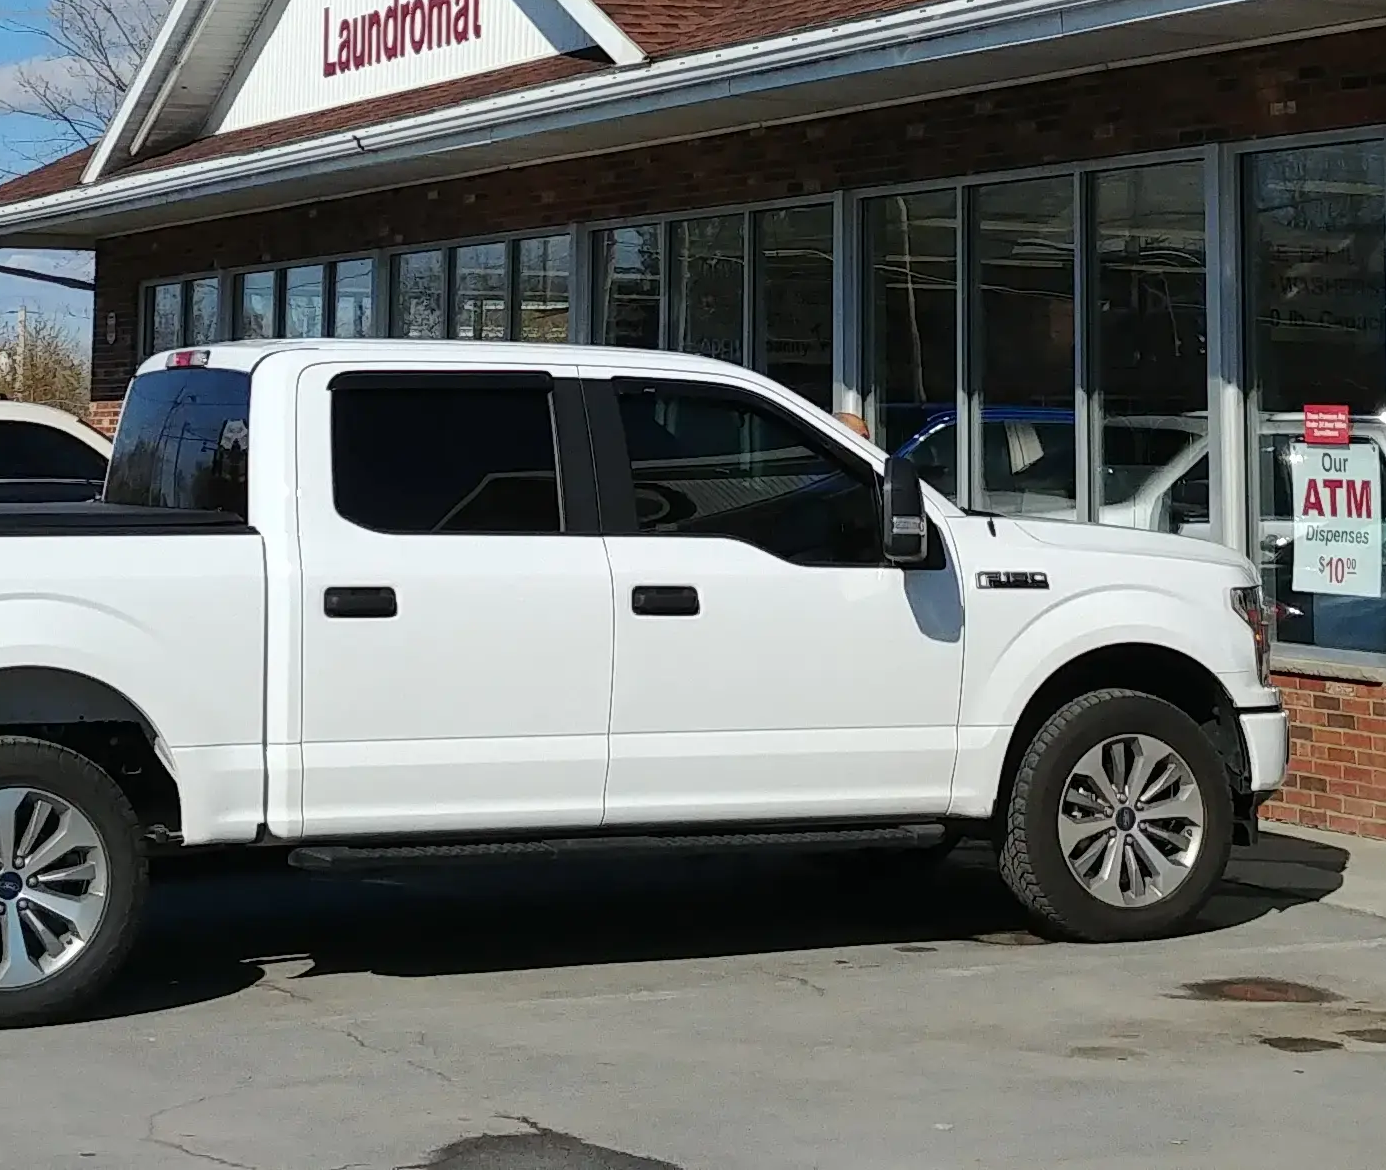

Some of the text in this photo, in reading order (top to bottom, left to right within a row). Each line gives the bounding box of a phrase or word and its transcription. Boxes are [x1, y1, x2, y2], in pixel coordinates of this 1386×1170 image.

[1321, 452, 1349, 473] Our
[1302, 478, 1372, 519] ATM
[1306, 524, 1370, 546] Dispenses
